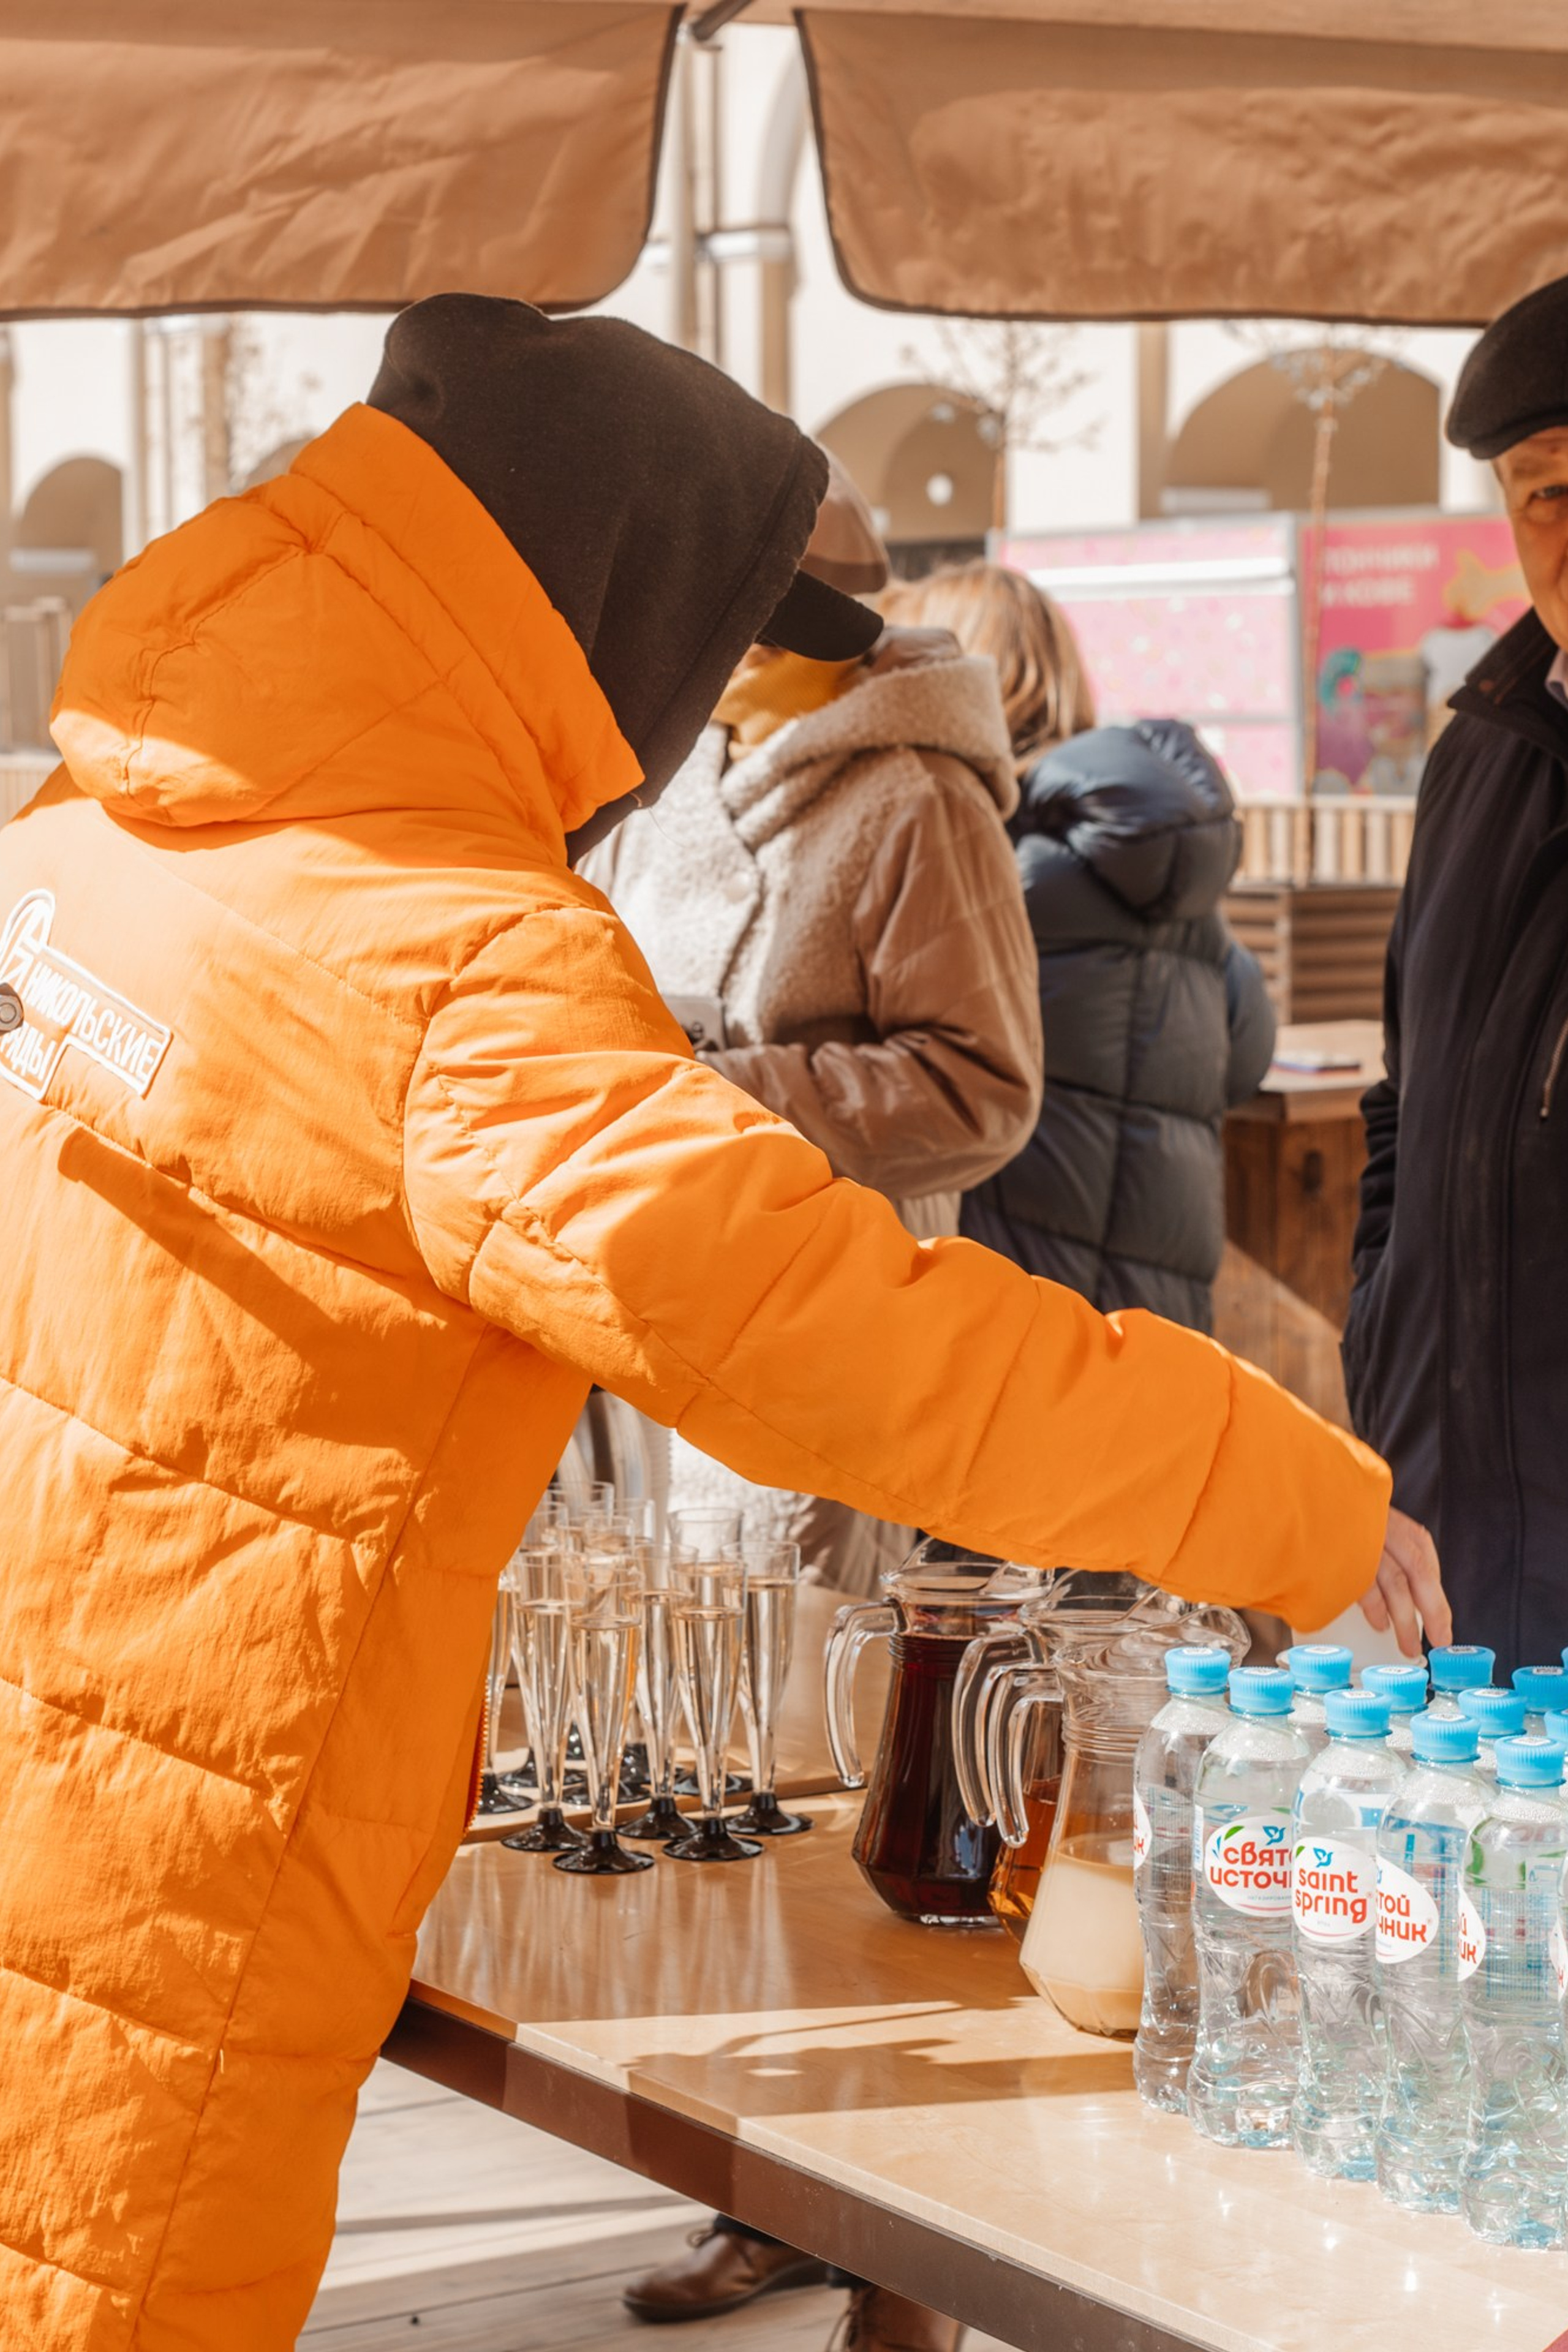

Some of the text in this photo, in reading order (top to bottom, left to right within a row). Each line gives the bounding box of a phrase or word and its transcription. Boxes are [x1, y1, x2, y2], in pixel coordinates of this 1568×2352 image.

[23, 961, 161, 1084] НИКОЛЬСКИЕ
[1224, 1841, 1292, 1866] свят
[1210, 1866, 1292, 1889] источ
[1298, 1868, 1358, 1893] saint
[1295, 1888, 1366, 1924] spring
[1377, 1891, 1410, 1917] той
